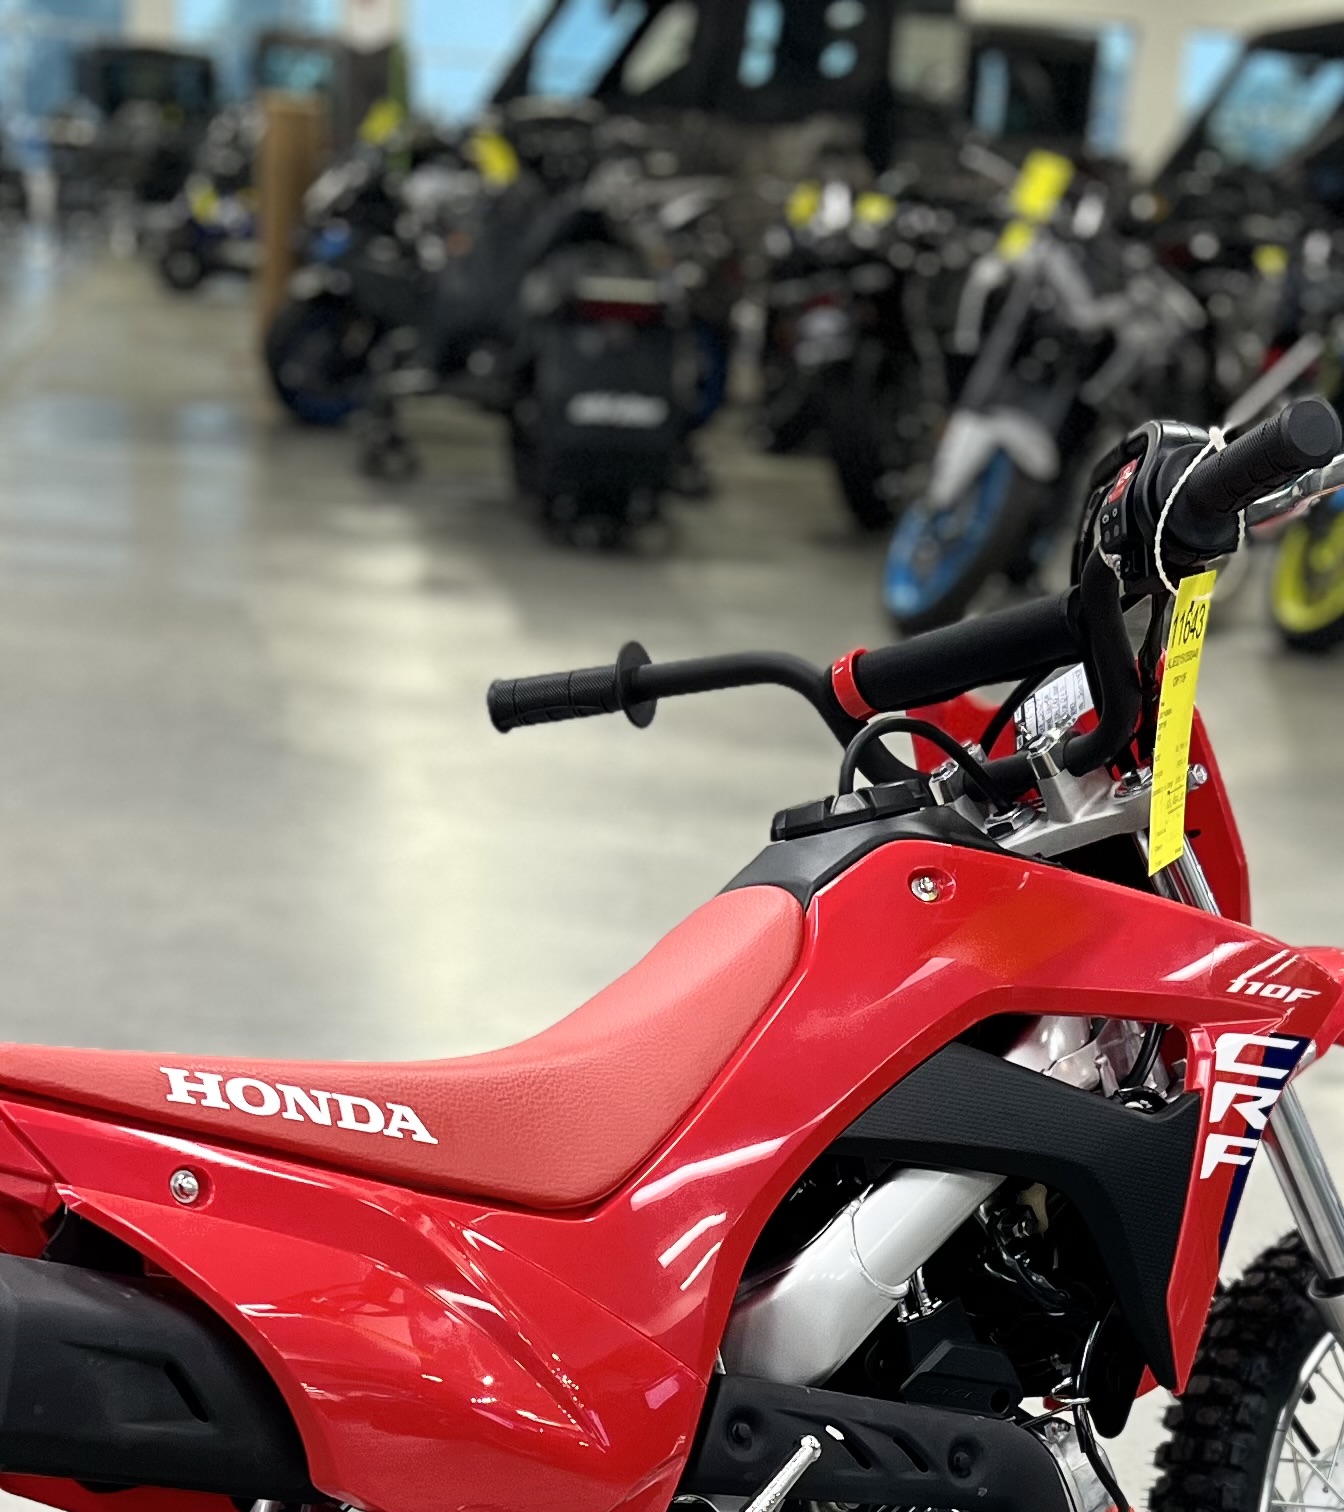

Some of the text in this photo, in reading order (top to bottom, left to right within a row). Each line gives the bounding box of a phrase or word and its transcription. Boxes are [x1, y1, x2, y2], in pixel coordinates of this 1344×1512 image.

[1170, 602, 1206, 648] 11643
[1225, 978, 1322, 1003] 110F
[159, 1066, 439, 1145] HONDA
[1200, 1032, 1301, 1180] CRF
